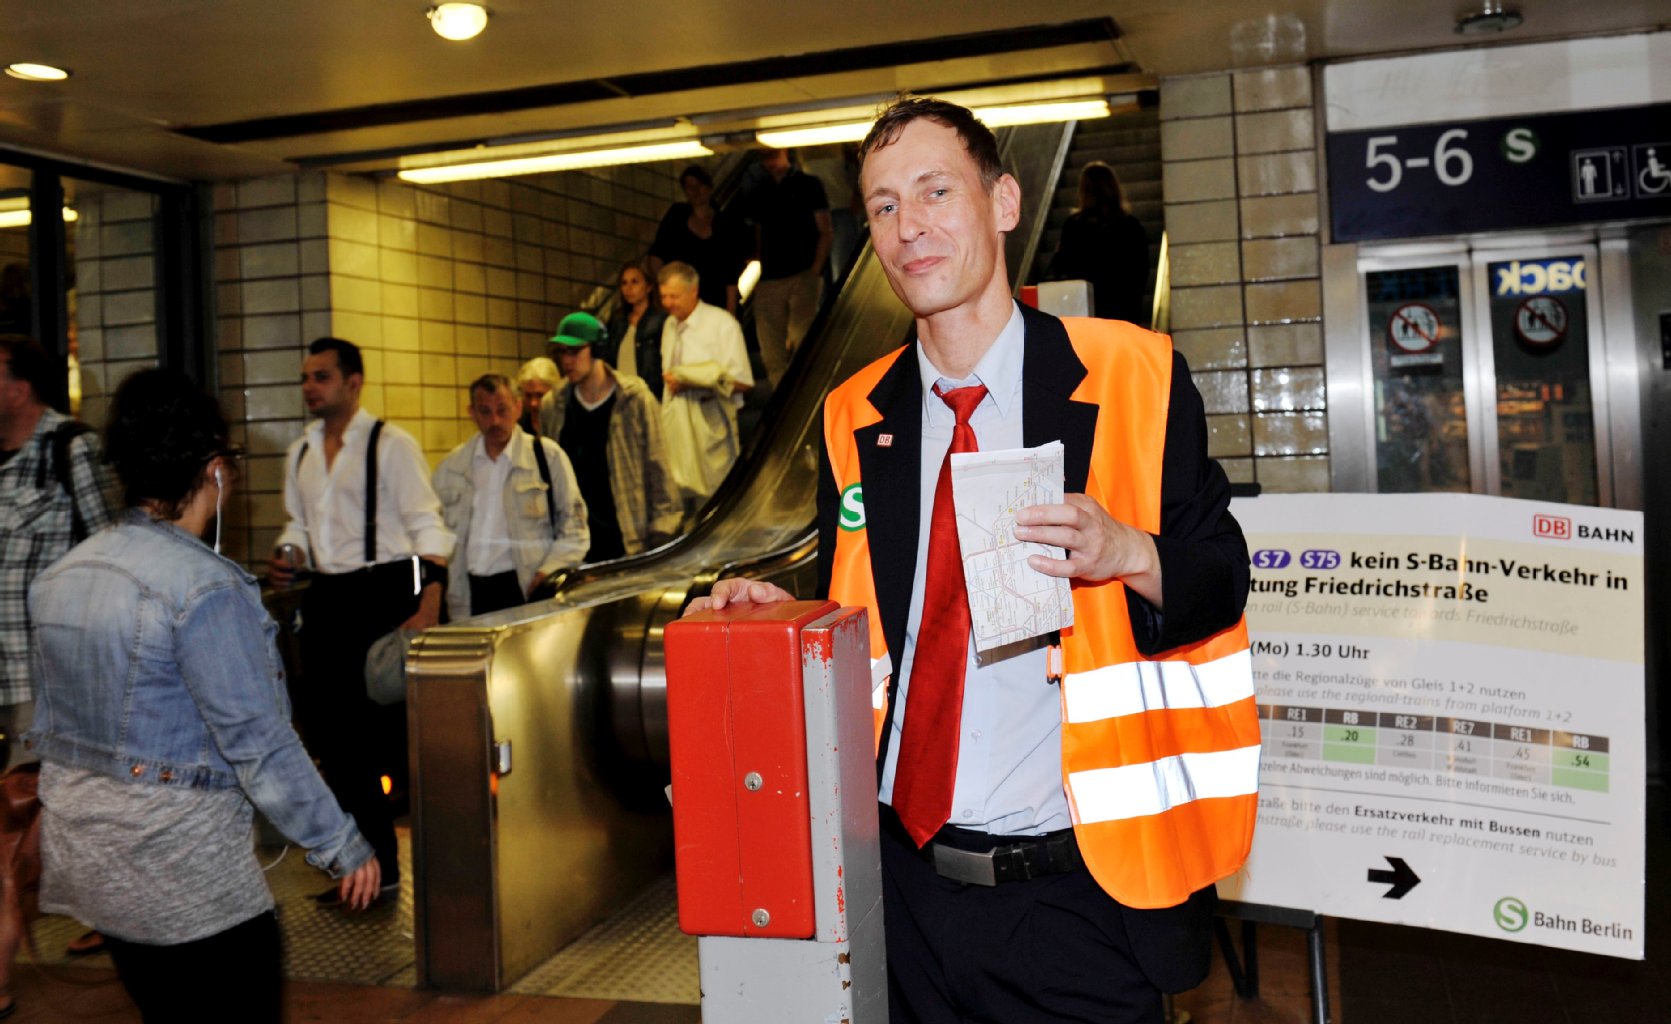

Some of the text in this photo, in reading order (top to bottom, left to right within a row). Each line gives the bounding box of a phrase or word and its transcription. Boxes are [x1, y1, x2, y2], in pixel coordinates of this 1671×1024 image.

[1365, 128, 1536, 193] 5-6 S
[840, 486, 866, 528] S
[1538, 518, 1635, 543] DB BAHN
[1258, 551, 1629, 590] S7 S75 kein S-Bahn-Verkehr in
[1304, 577, 1489, 603] Friedrichstraße
[1352, 606, 1401, 619] service
[1402, 607, 1462, 623] toards
[1466, 610, 1579, 635] Friedrichstraße
[1250, 641, 1371, 660] (Mo) 1.30 Uhr
[1272, 670, 1292, 682] die
[1295, 670, 1379, 688] Regionalzüge
[1383, 679, 1407, 689] von
[1411, 677, 1444, 691] Gleis
[1449, 680, 1475, 694] 1+2
[1479, 687, 1527, 701] nutzen
[1297, 687, 1318, 699] use
[1321, 688, 1341, 700] the
[1345, 689, 1398, 705] regional
[1401, 695, 1441, 707] trains
[1444, 698, 1477, 712] from
[1481, 701, 1541, 720] platform
[1546, 710, 1573, 723] 1+2
[1287, 708, 1589, 749] RE1 RB RE2 RE7 RE1 RB
[1340, 730, 1359, 742] .20
[1395, 734, 1415, 747] .28
[1571, 755, 1590, 768] .54
[1289, 764, 1362, 781] Abweichungen
[1365, 769, 1387, 782] sind
[1388, 771, 1433, 788] möglich.
[1436, 776, 1463, 790] Bitte
[1465, 778, 1529, 799] informieren
[1531, 787, 1549, 800] Sie
[1325, 803, 1350, 816] den
[1354, 805, 1454, 826] Ersatzverkehr
[1459, 818, 1485, 831] mit
[1489, 820, 1541, 839] Bussen
[1545, 830, 1594, 846] nutzen
[1351, 824, 1374, 835] use
[1376, 825, 1399, 838] the
[1401, 828, 1426, 842] rail
[1428, 831, 1515, 853] replacement
[1519, 843, 1568, 861] service
[1571, 850, 1588, 866] by
[1592, 852, 1617, 868] bus
[1494, 897, 1633, 940] S Bahn Berlin
